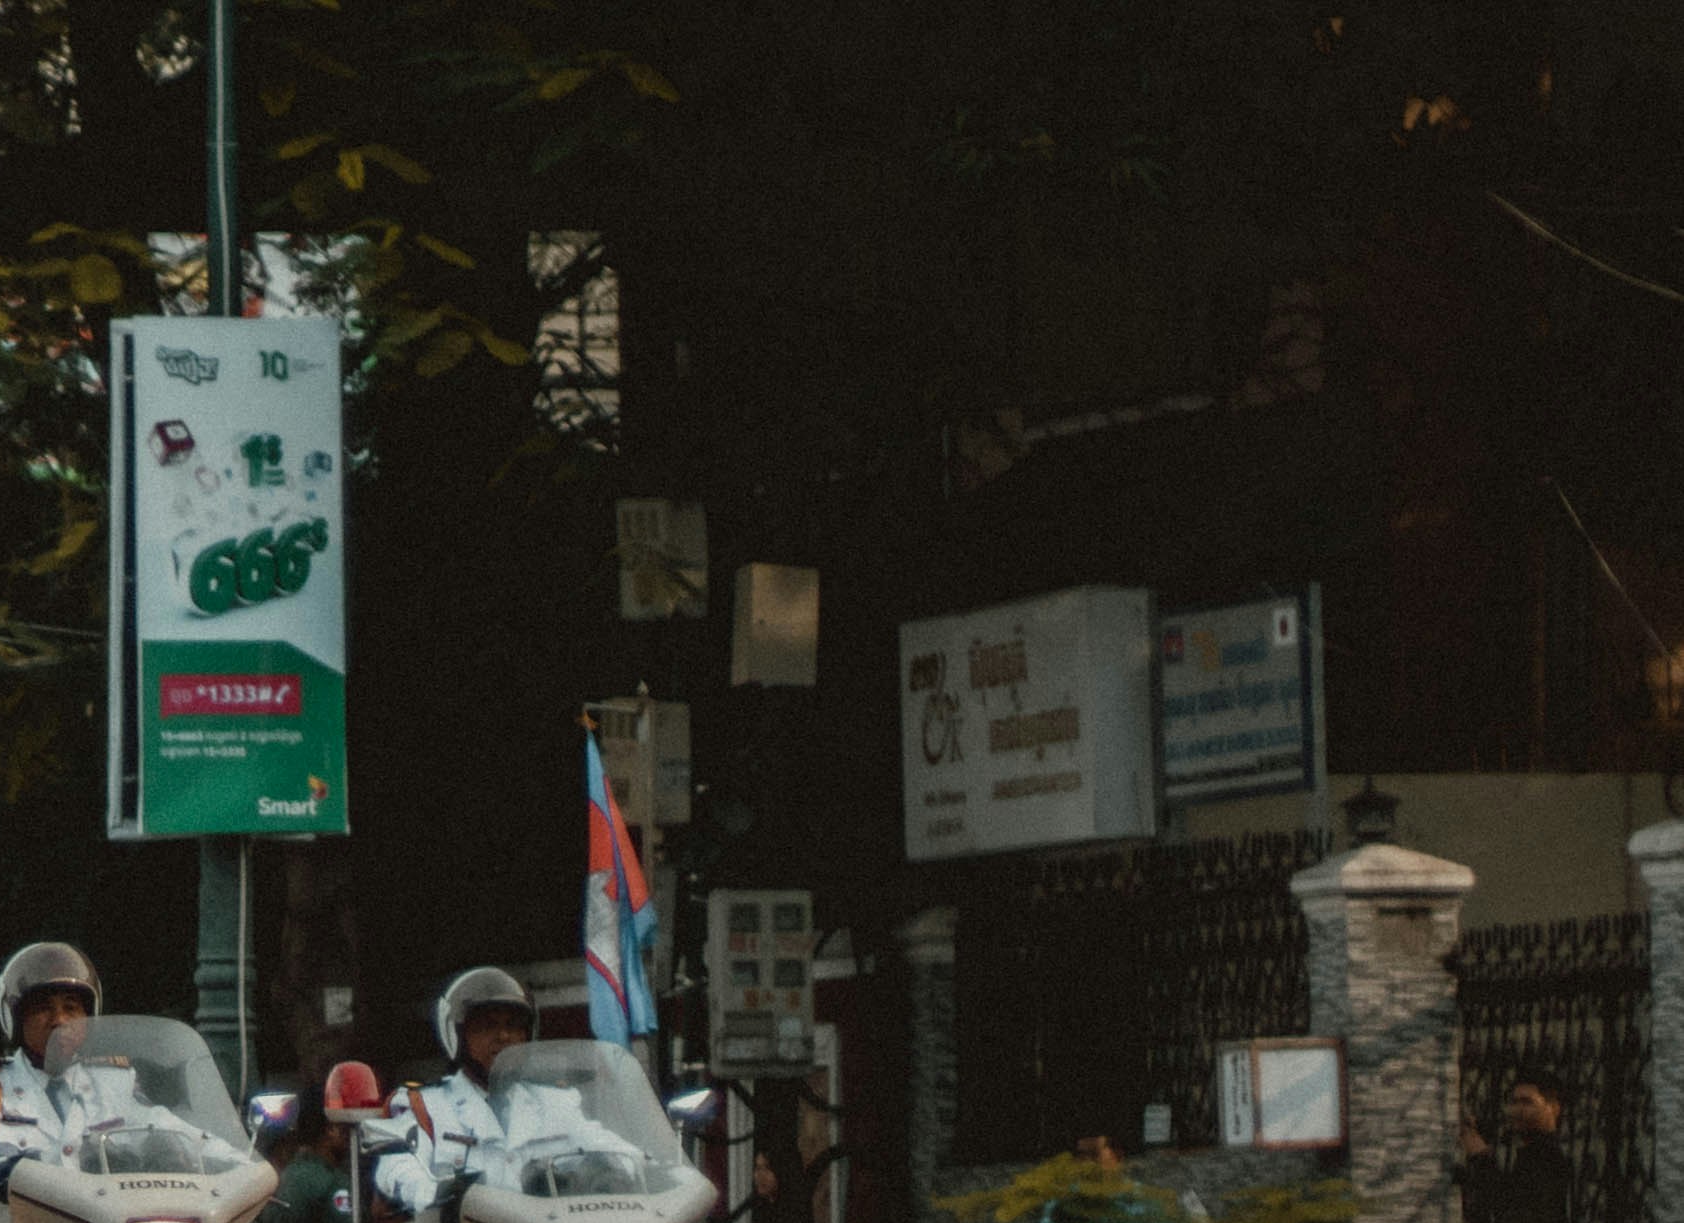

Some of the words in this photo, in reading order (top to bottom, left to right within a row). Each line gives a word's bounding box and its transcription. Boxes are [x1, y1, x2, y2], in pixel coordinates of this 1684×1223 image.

[258, 797, 317, 816] Smart
[119, 1180, 200, 1191] HONDA
[568, 1201, 645, 1213] HONDA
